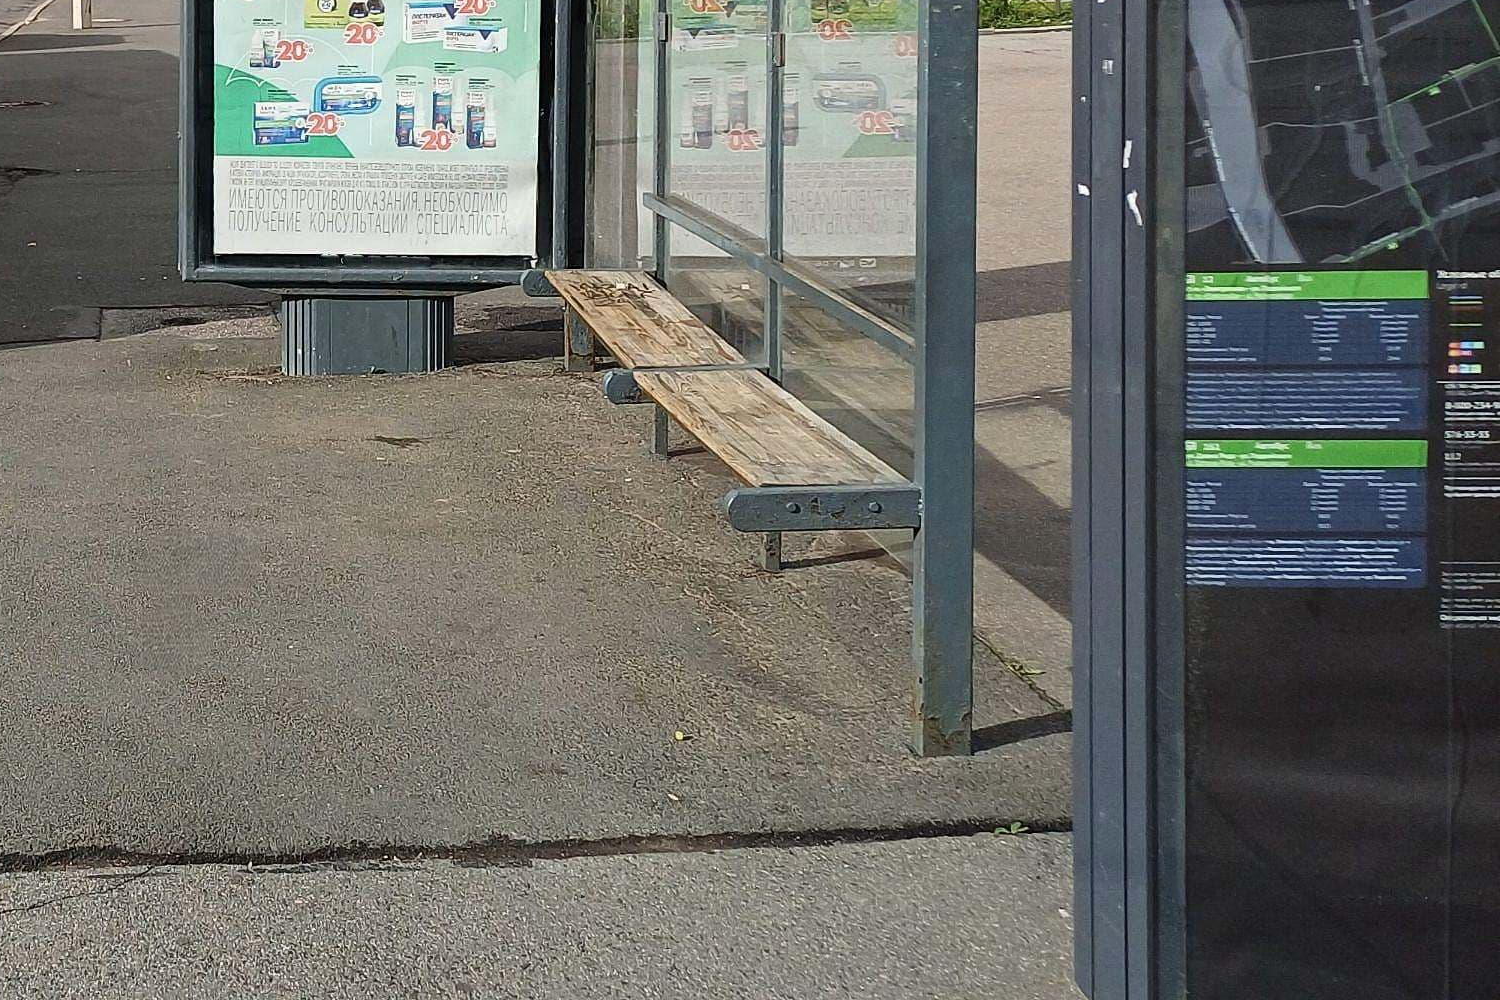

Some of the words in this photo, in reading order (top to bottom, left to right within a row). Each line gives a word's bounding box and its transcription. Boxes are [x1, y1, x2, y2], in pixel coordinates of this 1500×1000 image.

[229, 188, 287, 210] ИМЕЮТСЯ
[424, 191, 508, 214] НЕОБХОДИМО
[229, 210, 301, 232] ПОЛУЧЕНИЕ
[309, 211, 408, 236] КОНСУЛЬТАЦИИ
[416, 213, 508, 237] СПЕЦИАЛИСТА
